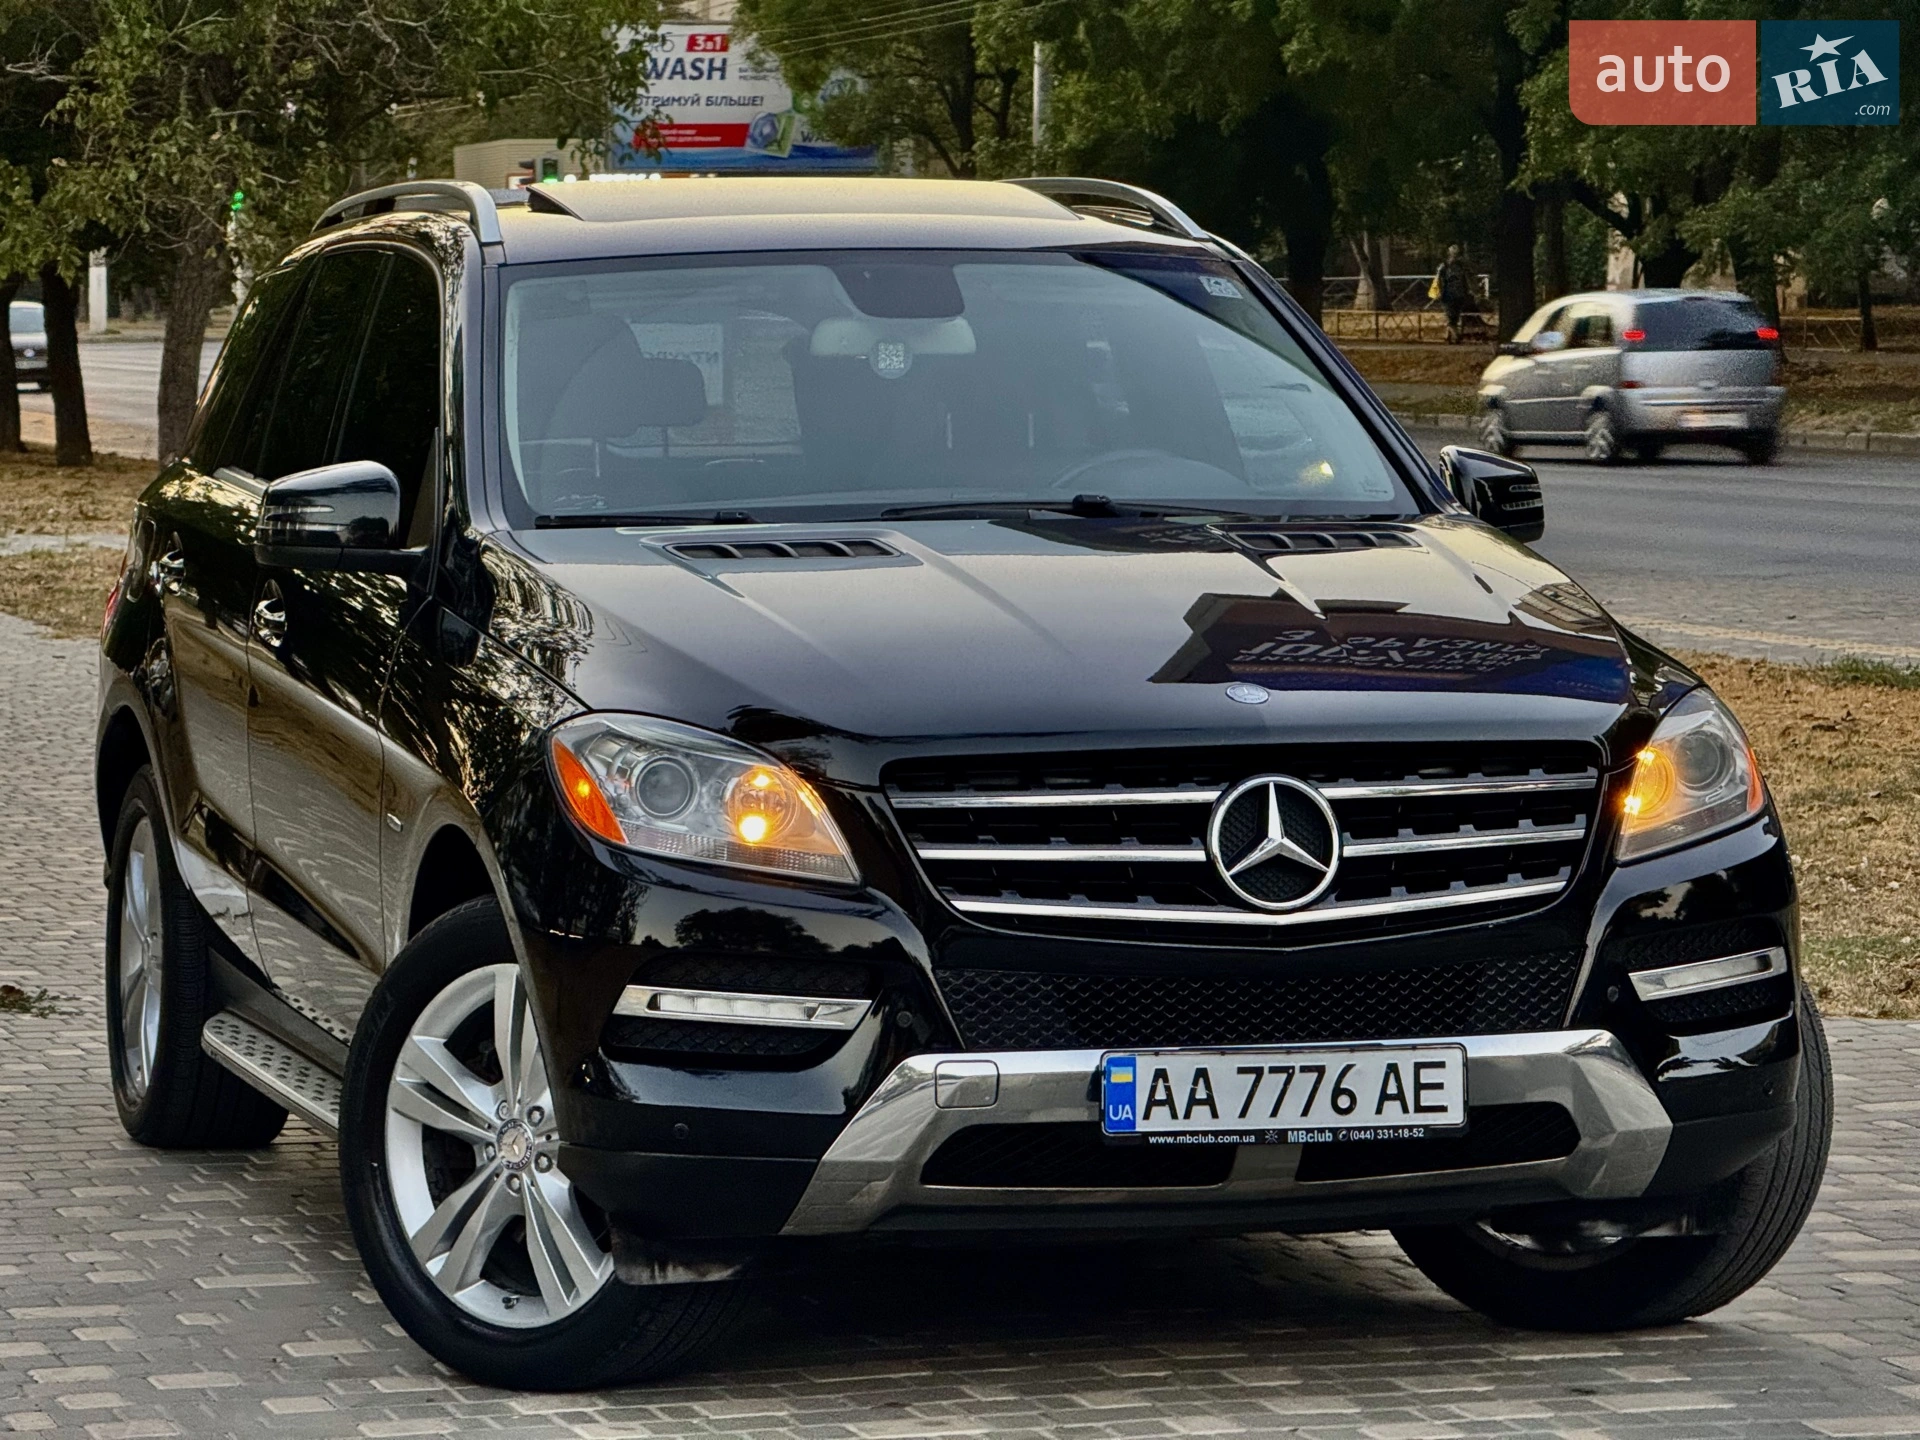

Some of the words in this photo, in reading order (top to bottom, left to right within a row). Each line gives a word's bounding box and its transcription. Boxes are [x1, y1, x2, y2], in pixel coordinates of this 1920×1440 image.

[705, 95, 764, 107] БІЛЬШЕ!
[1142, 1067, 1220, 1121] AA
[1236, 1063, 1359, 1120] 7776
[1374, 1061, 1449, 1116] AE
[1109, 1104, 1133, 1121] UA
[1148, 1132, 1256, 1145] www.mbclub.com.ua
[1287, 1129, 1333, 1143] MBclub
[1349, 1129, 1375, 1142] (044)
[1376, 1127, 1425, 1140] 331-18-52
